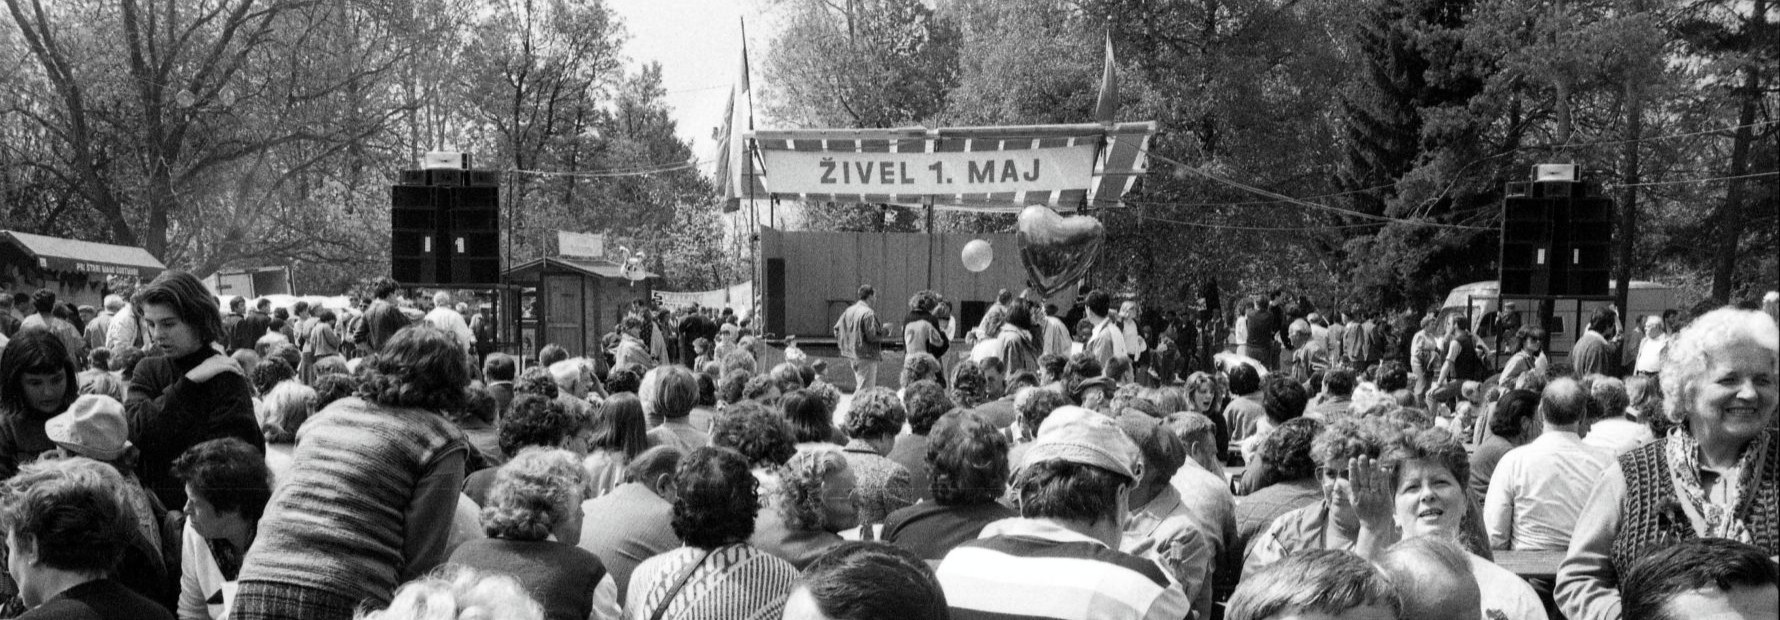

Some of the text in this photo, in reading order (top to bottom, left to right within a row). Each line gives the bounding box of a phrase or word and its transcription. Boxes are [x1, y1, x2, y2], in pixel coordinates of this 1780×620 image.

[819, 157, 1039, 184] ŽIVEL 1. MAJ
